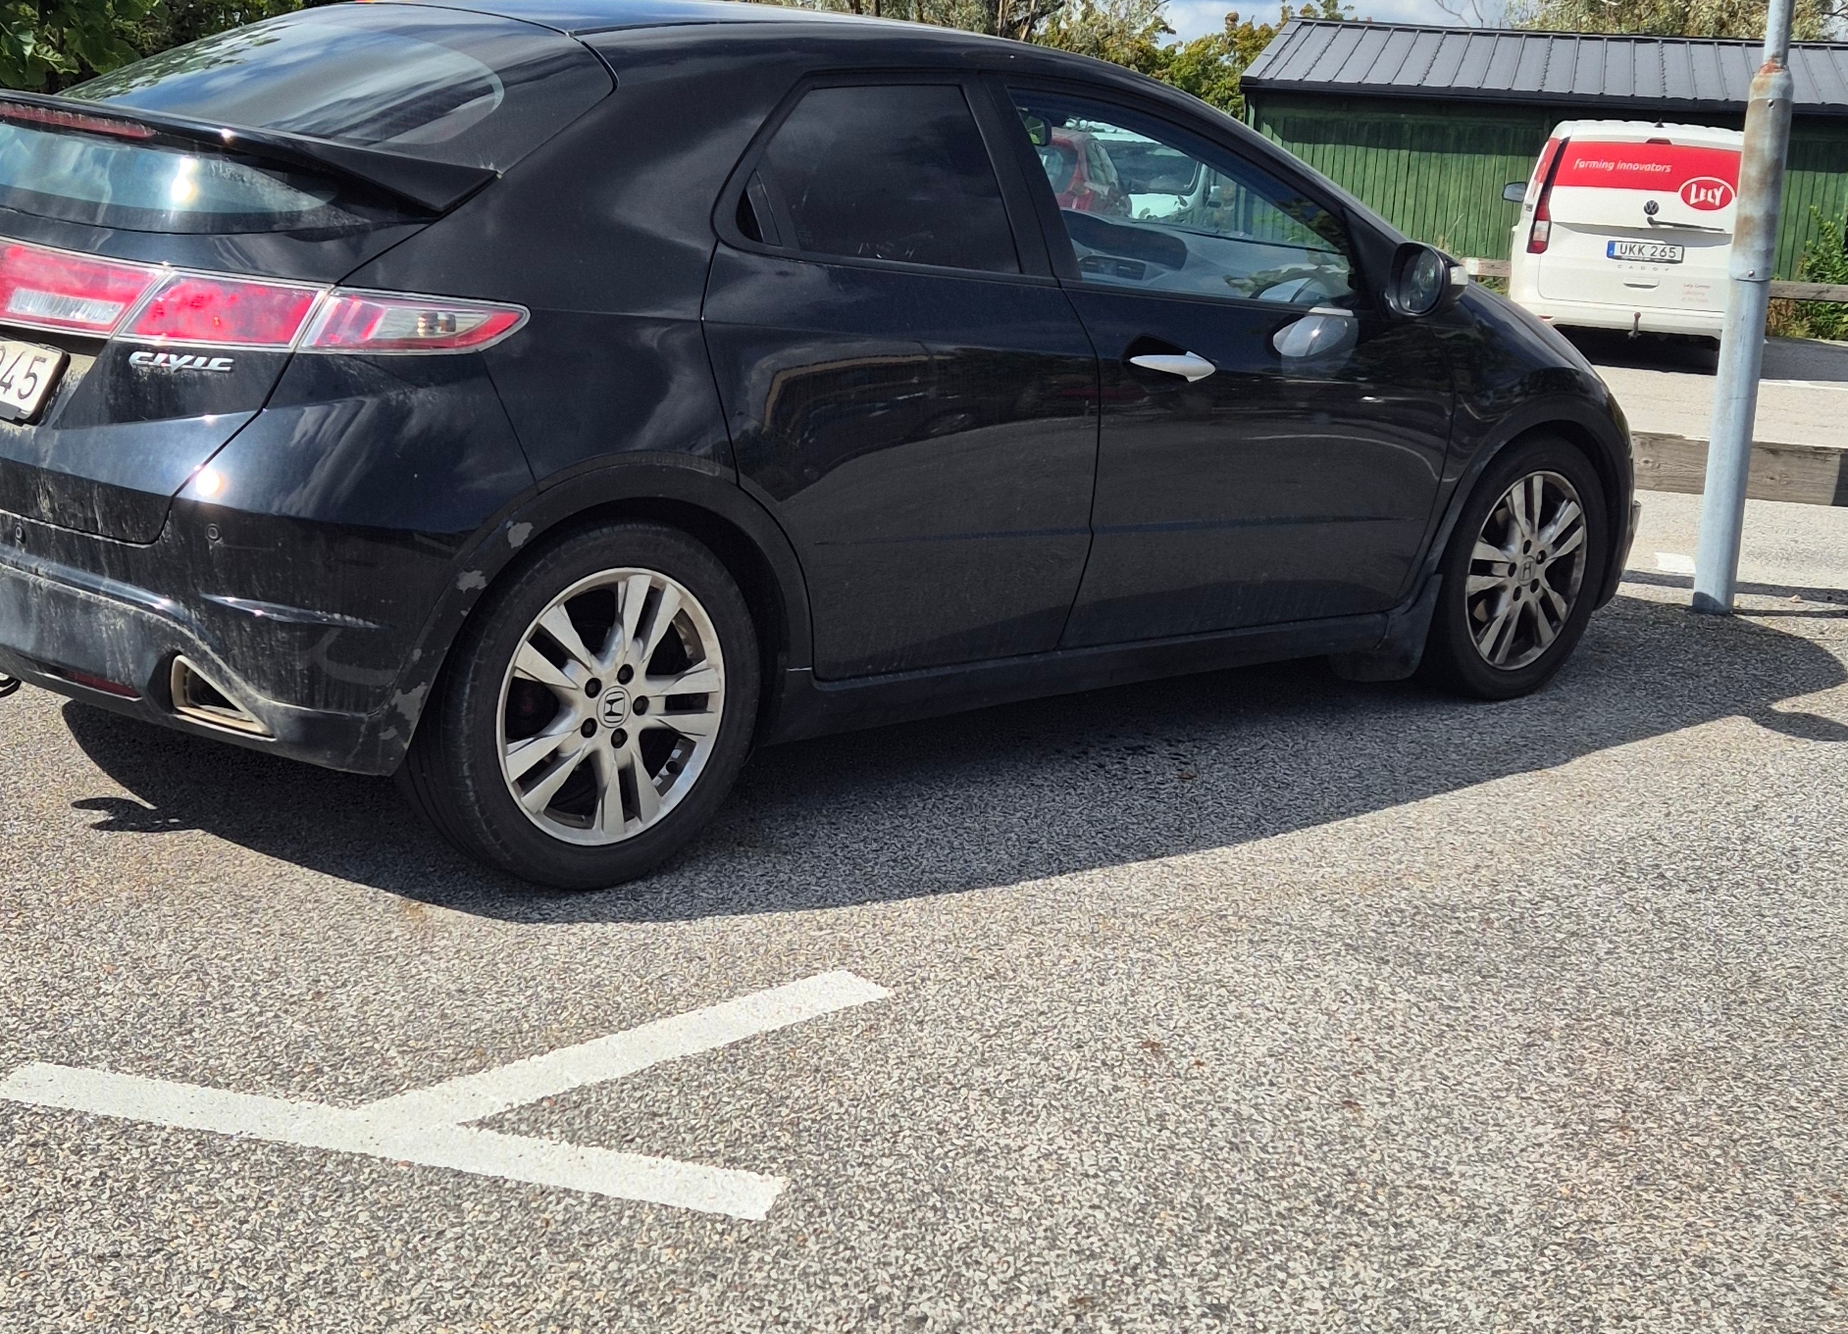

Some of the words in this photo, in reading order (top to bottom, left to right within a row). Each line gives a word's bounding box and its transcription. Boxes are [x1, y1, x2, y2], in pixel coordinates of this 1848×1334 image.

[1574, 158, 1615, 171] farming
[1616, 160, 1672, 173] innovators
[1690, 183, 1725, 206] LELY
[1619, 243, 1645, 256] UKK
[1650, 245, 1676, 259] 265
[0, 345, 47, 400] 45
[128, 350, 235, 373] CIVIC
